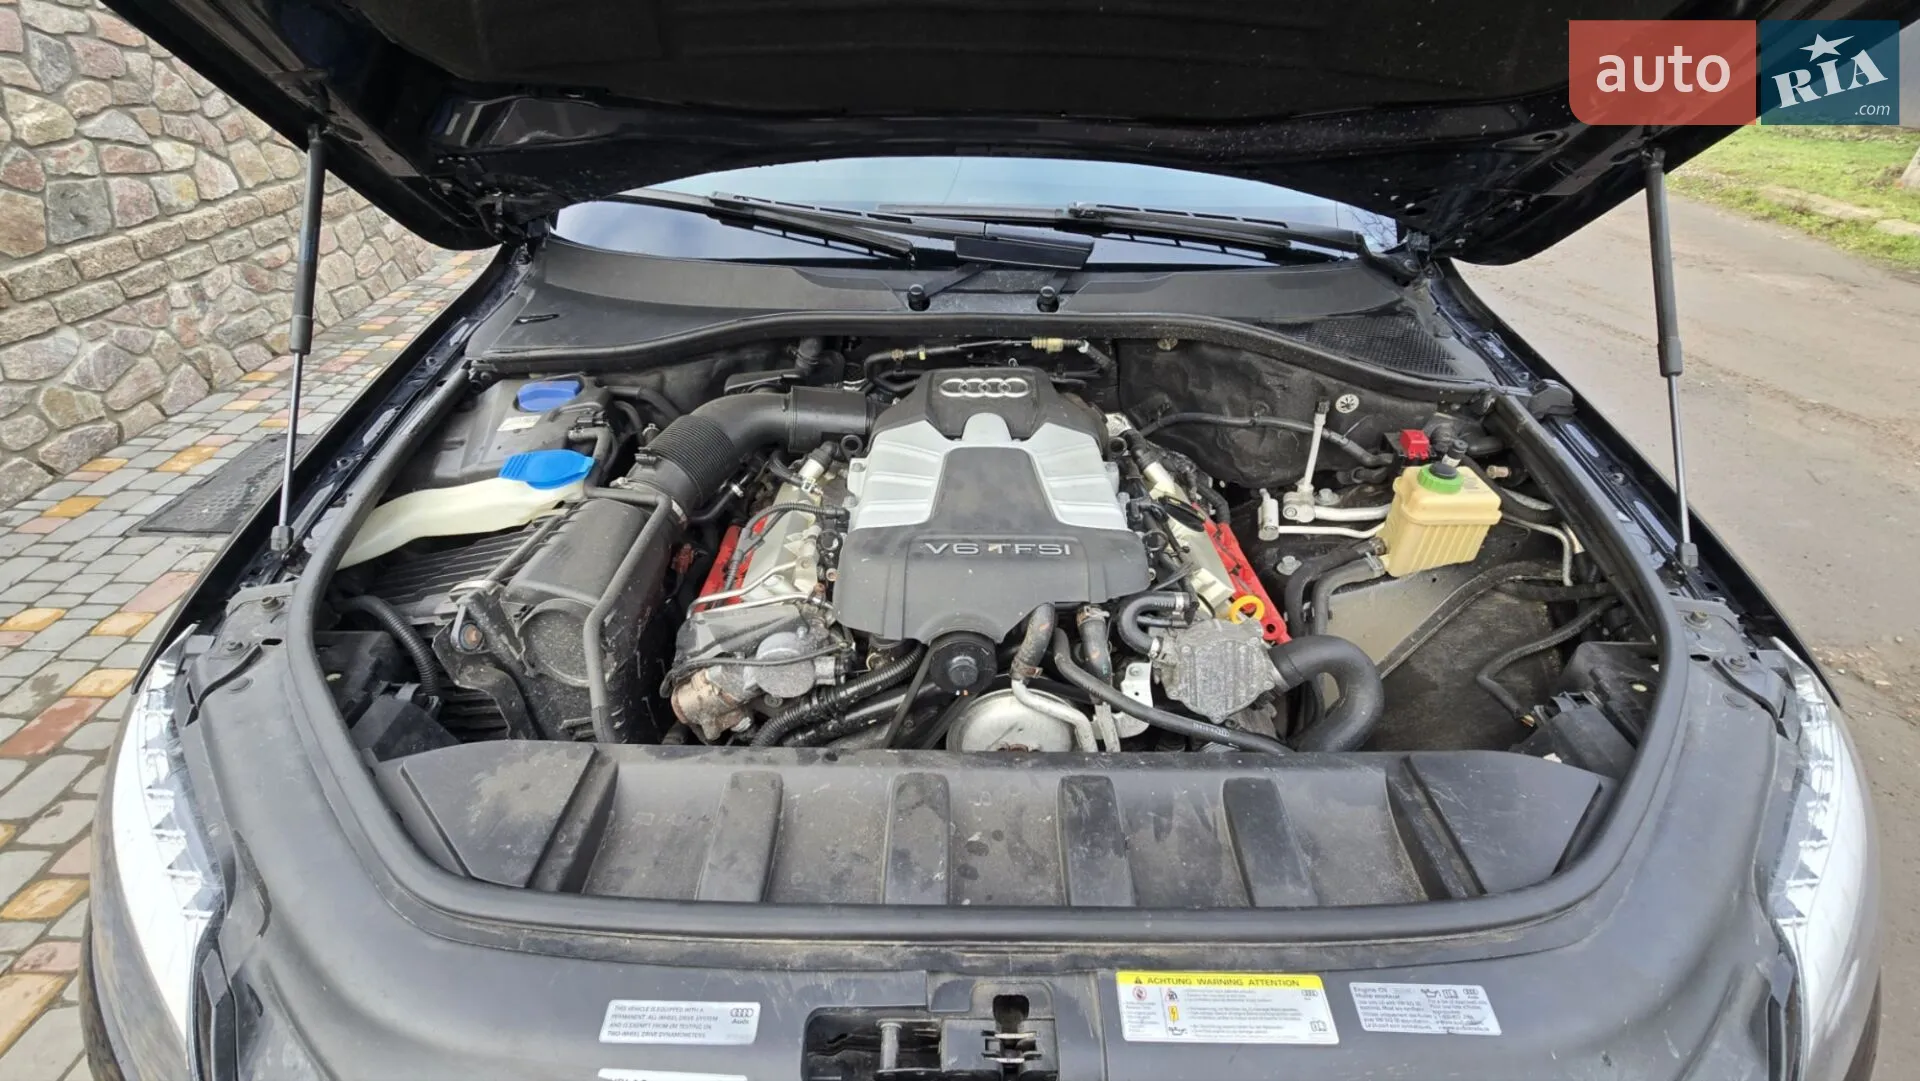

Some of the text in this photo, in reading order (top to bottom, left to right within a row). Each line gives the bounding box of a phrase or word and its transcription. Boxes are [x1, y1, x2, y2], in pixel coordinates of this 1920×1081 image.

[924, 542, 1071, 556] V6 TFSI
[1147, 976, 1300, 987] ACHTUNG WARNING ATTENTION
